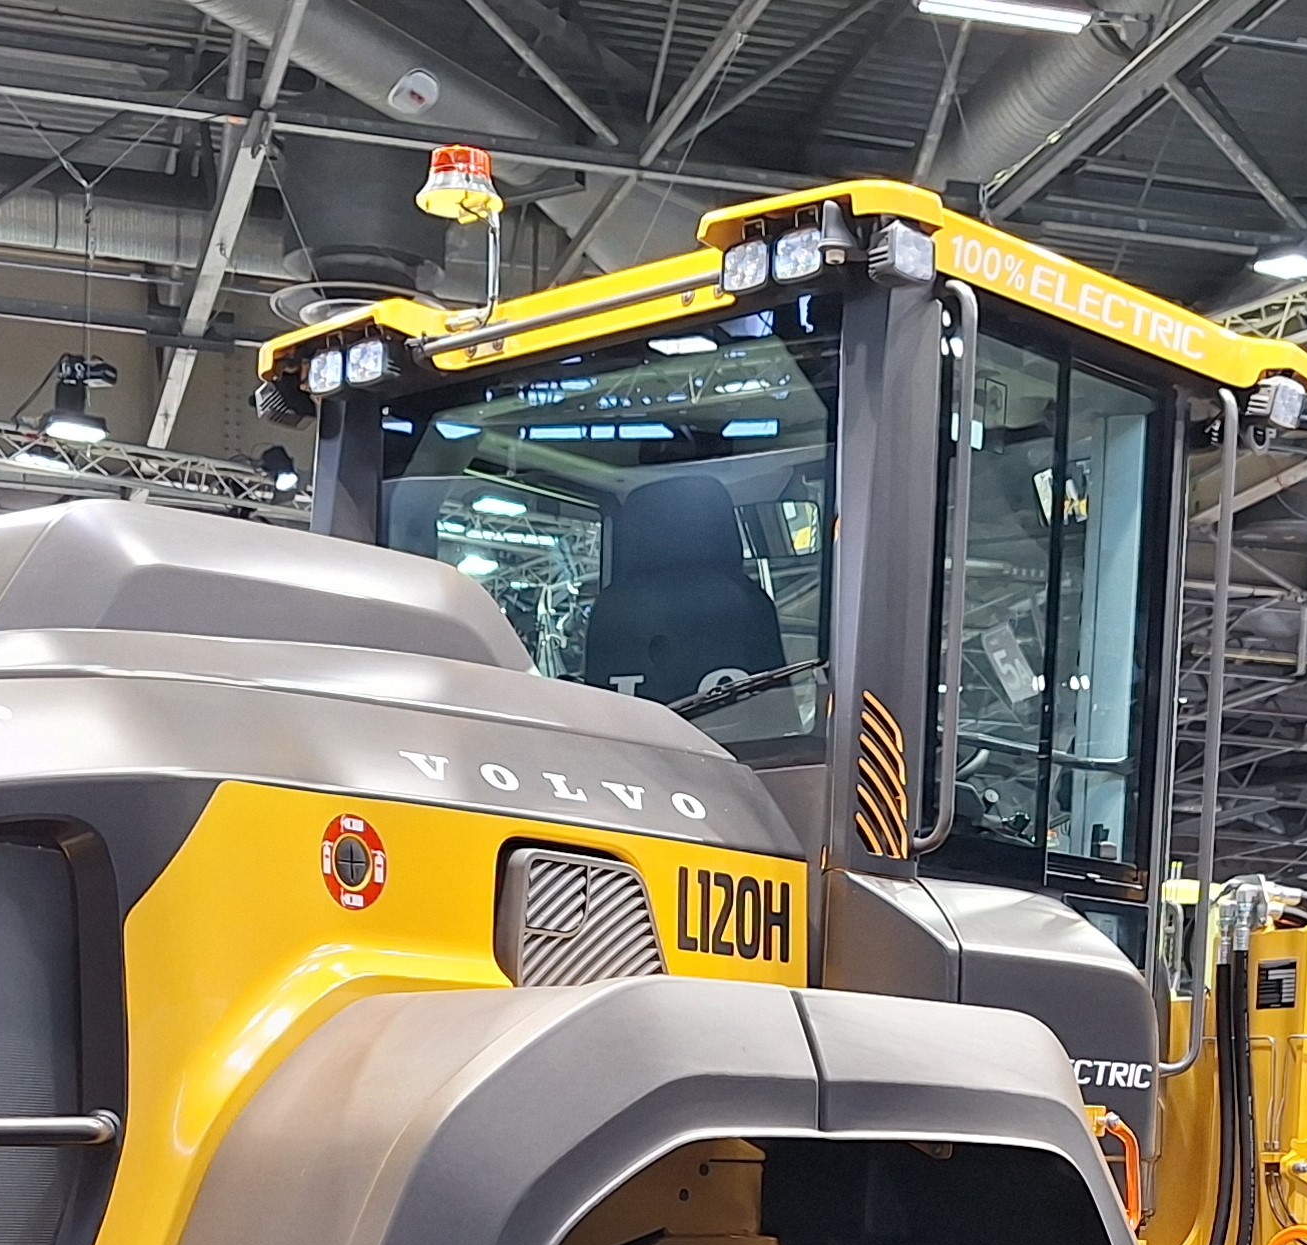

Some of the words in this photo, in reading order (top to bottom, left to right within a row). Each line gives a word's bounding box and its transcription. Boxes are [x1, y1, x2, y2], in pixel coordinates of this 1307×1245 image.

[951, 233, 1027, 291] 100%
[1029, 265, 1206, 361] ELECTRIC
[398, 750, 707, 820] VOLVO
[677, 865, 790, 963] L120H
[1069, 1059, 1152, 1089] CTRIC
